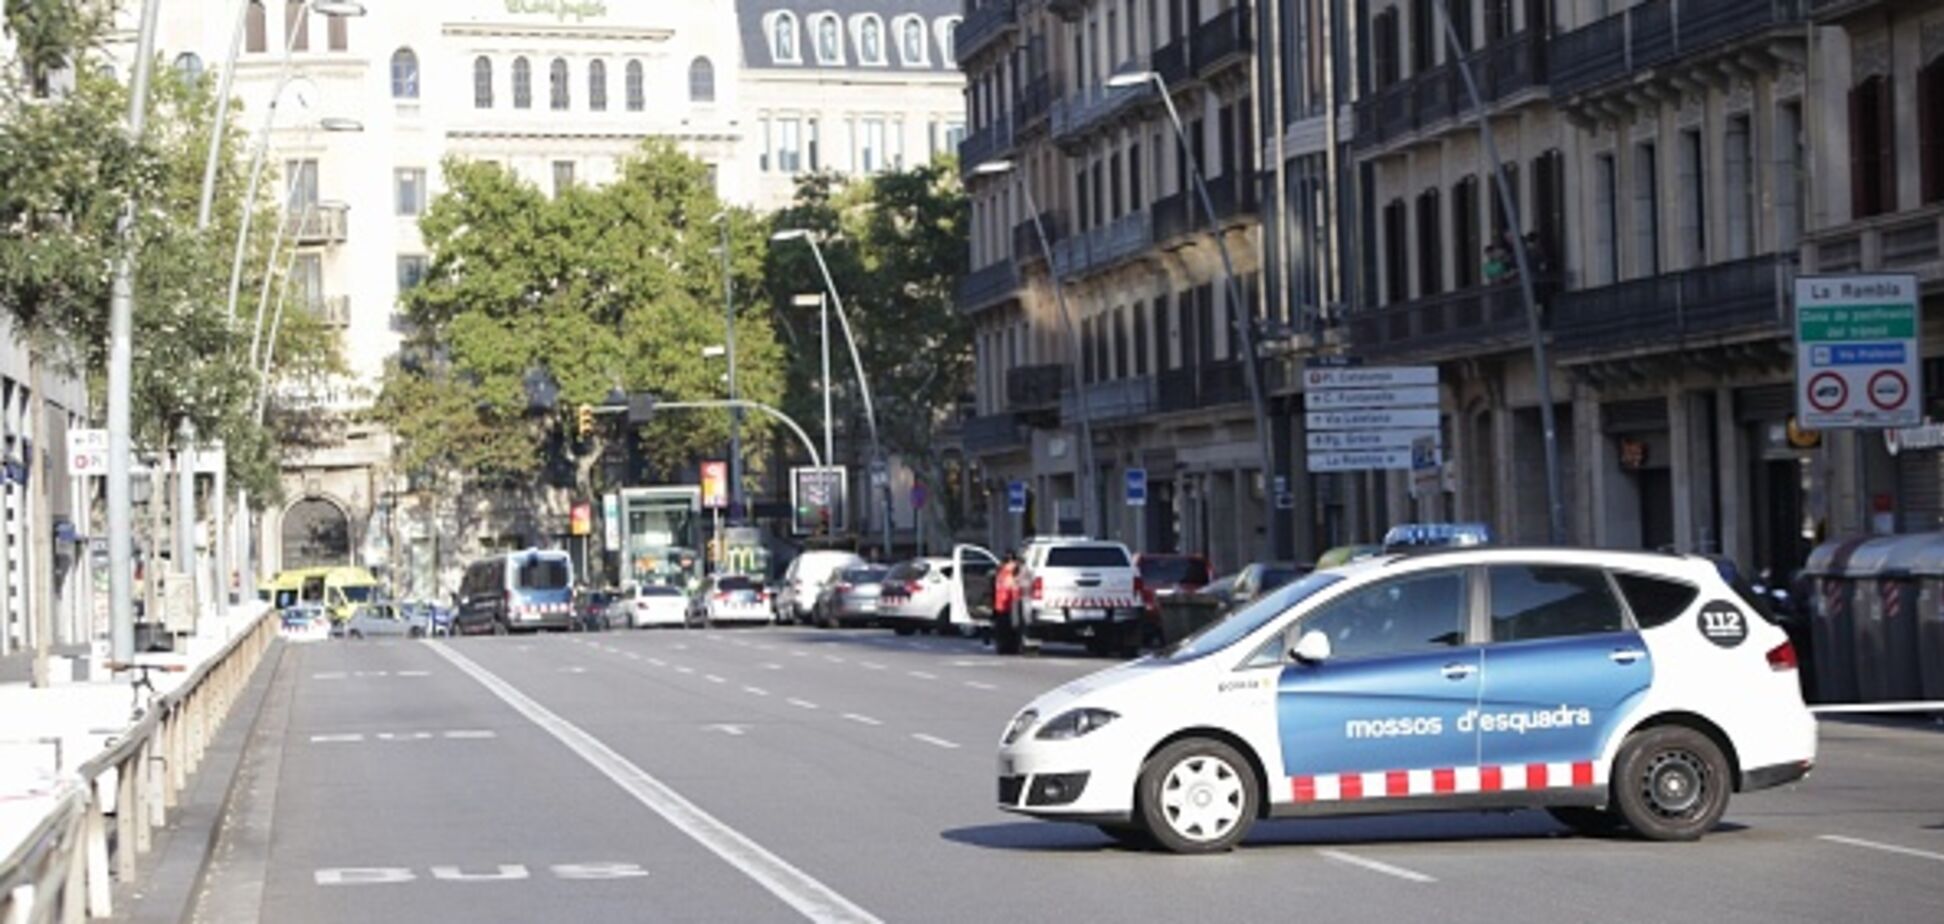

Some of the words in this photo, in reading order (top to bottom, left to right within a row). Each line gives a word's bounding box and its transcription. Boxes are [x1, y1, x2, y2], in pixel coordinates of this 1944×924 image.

[1811, 284, 1831, 299] La
[1841, 281, 1901, 298] Rambla
[1325, 414, 1341, 424] Via
[1326, 456, 1339, 466] La
[1703, 611, 1741, 631] 112
[1345, 713, 1443, 740] mossos
[1456, 704, 1593, 734] d'esquadra
[314, 862, 650, 886] BUS
